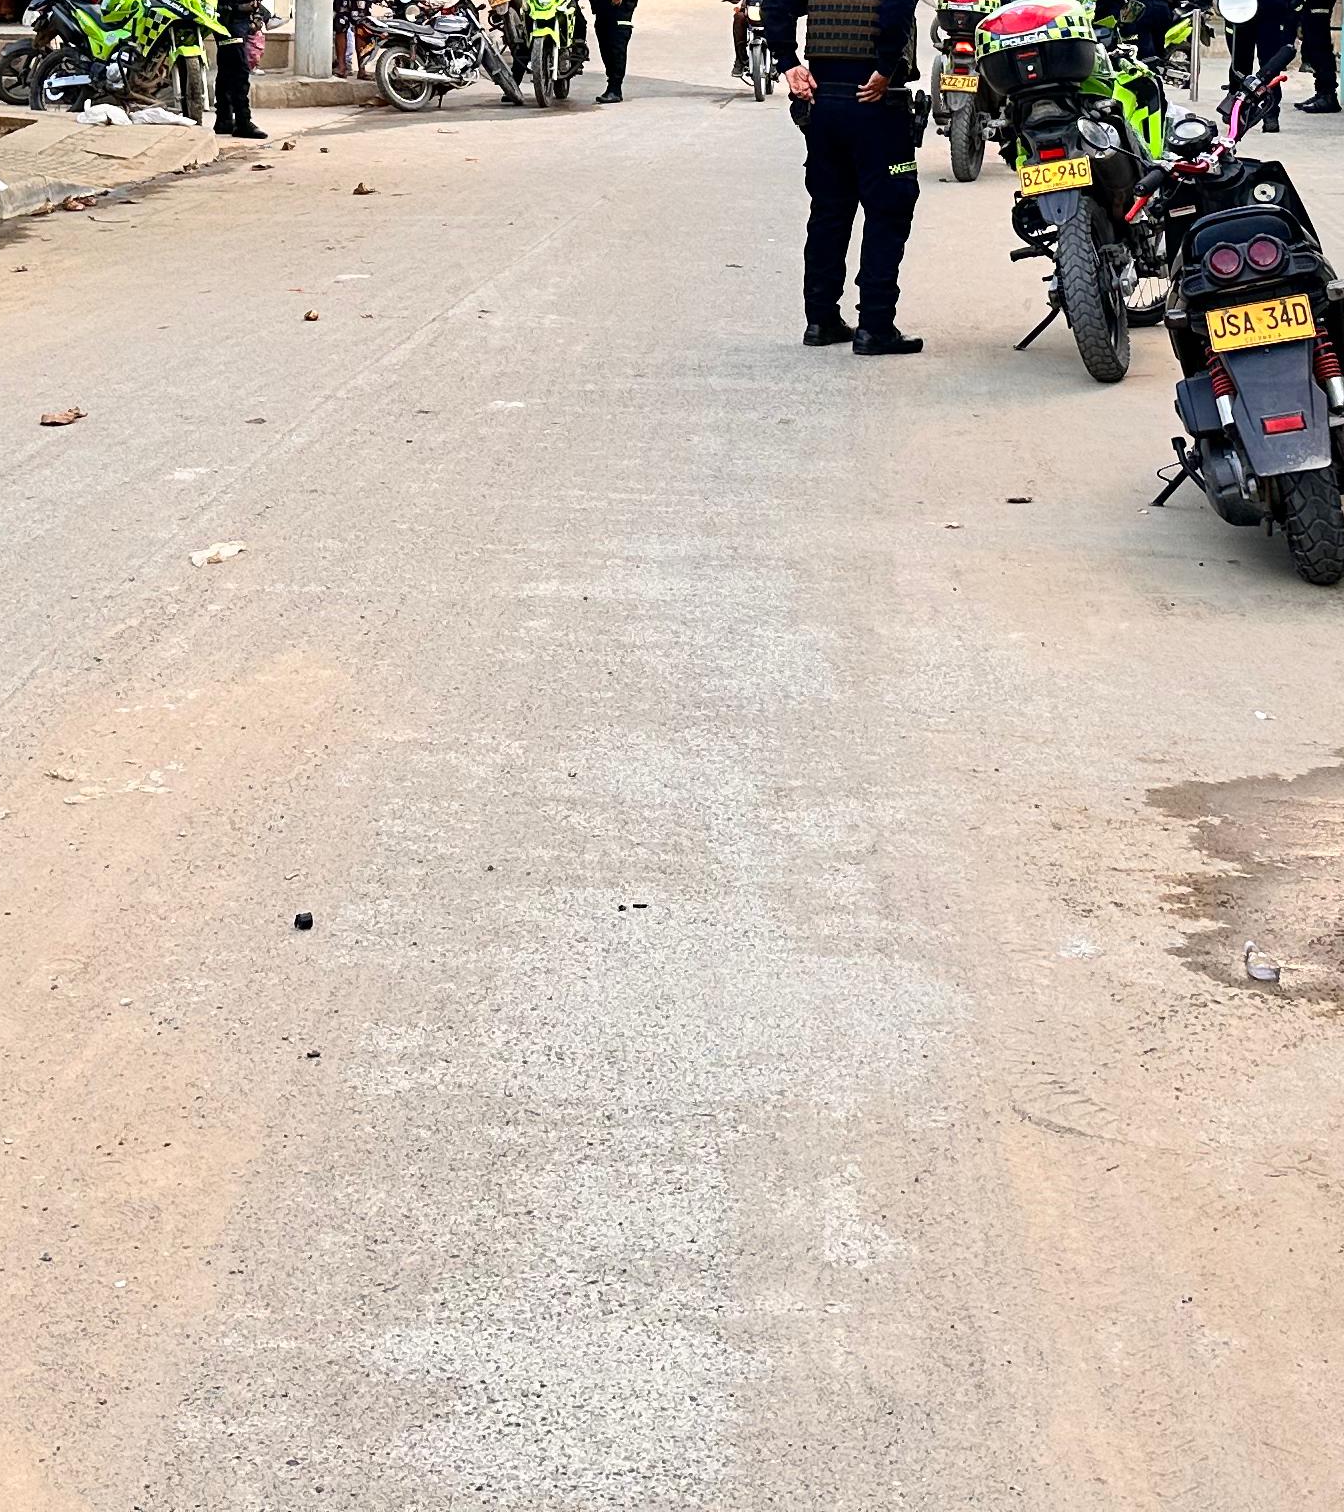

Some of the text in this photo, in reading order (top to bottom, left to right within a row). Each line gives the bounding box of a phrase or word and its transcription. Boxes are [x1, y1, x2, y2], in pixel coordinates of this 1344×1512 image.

[1022, 161, 1088, 188] BZC 94G
[1213, 302, 1308, 339] JSA 34D
